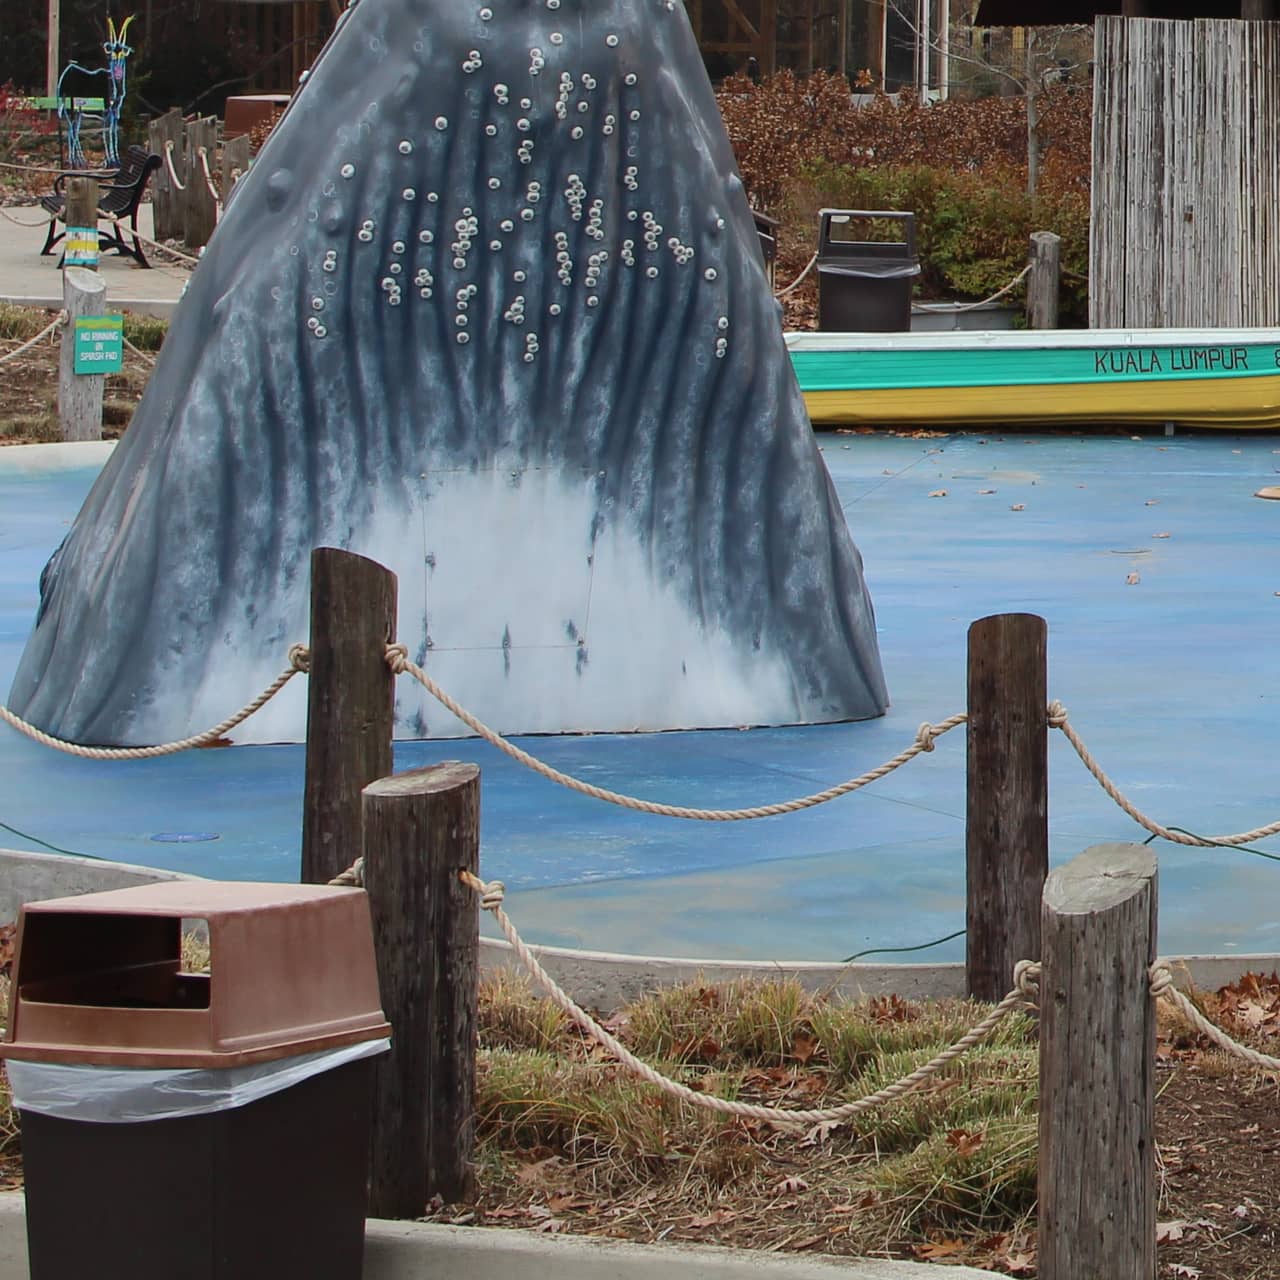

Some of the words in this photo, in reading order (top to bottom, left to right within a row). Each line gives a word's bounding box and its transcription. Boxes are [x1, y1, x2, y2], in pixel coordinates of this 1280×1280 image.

[80, 331, 91, 341] NO
[1095, 349, 1162, 373] KUALA
[1170, 347, 1249, 371] LUMPUR
